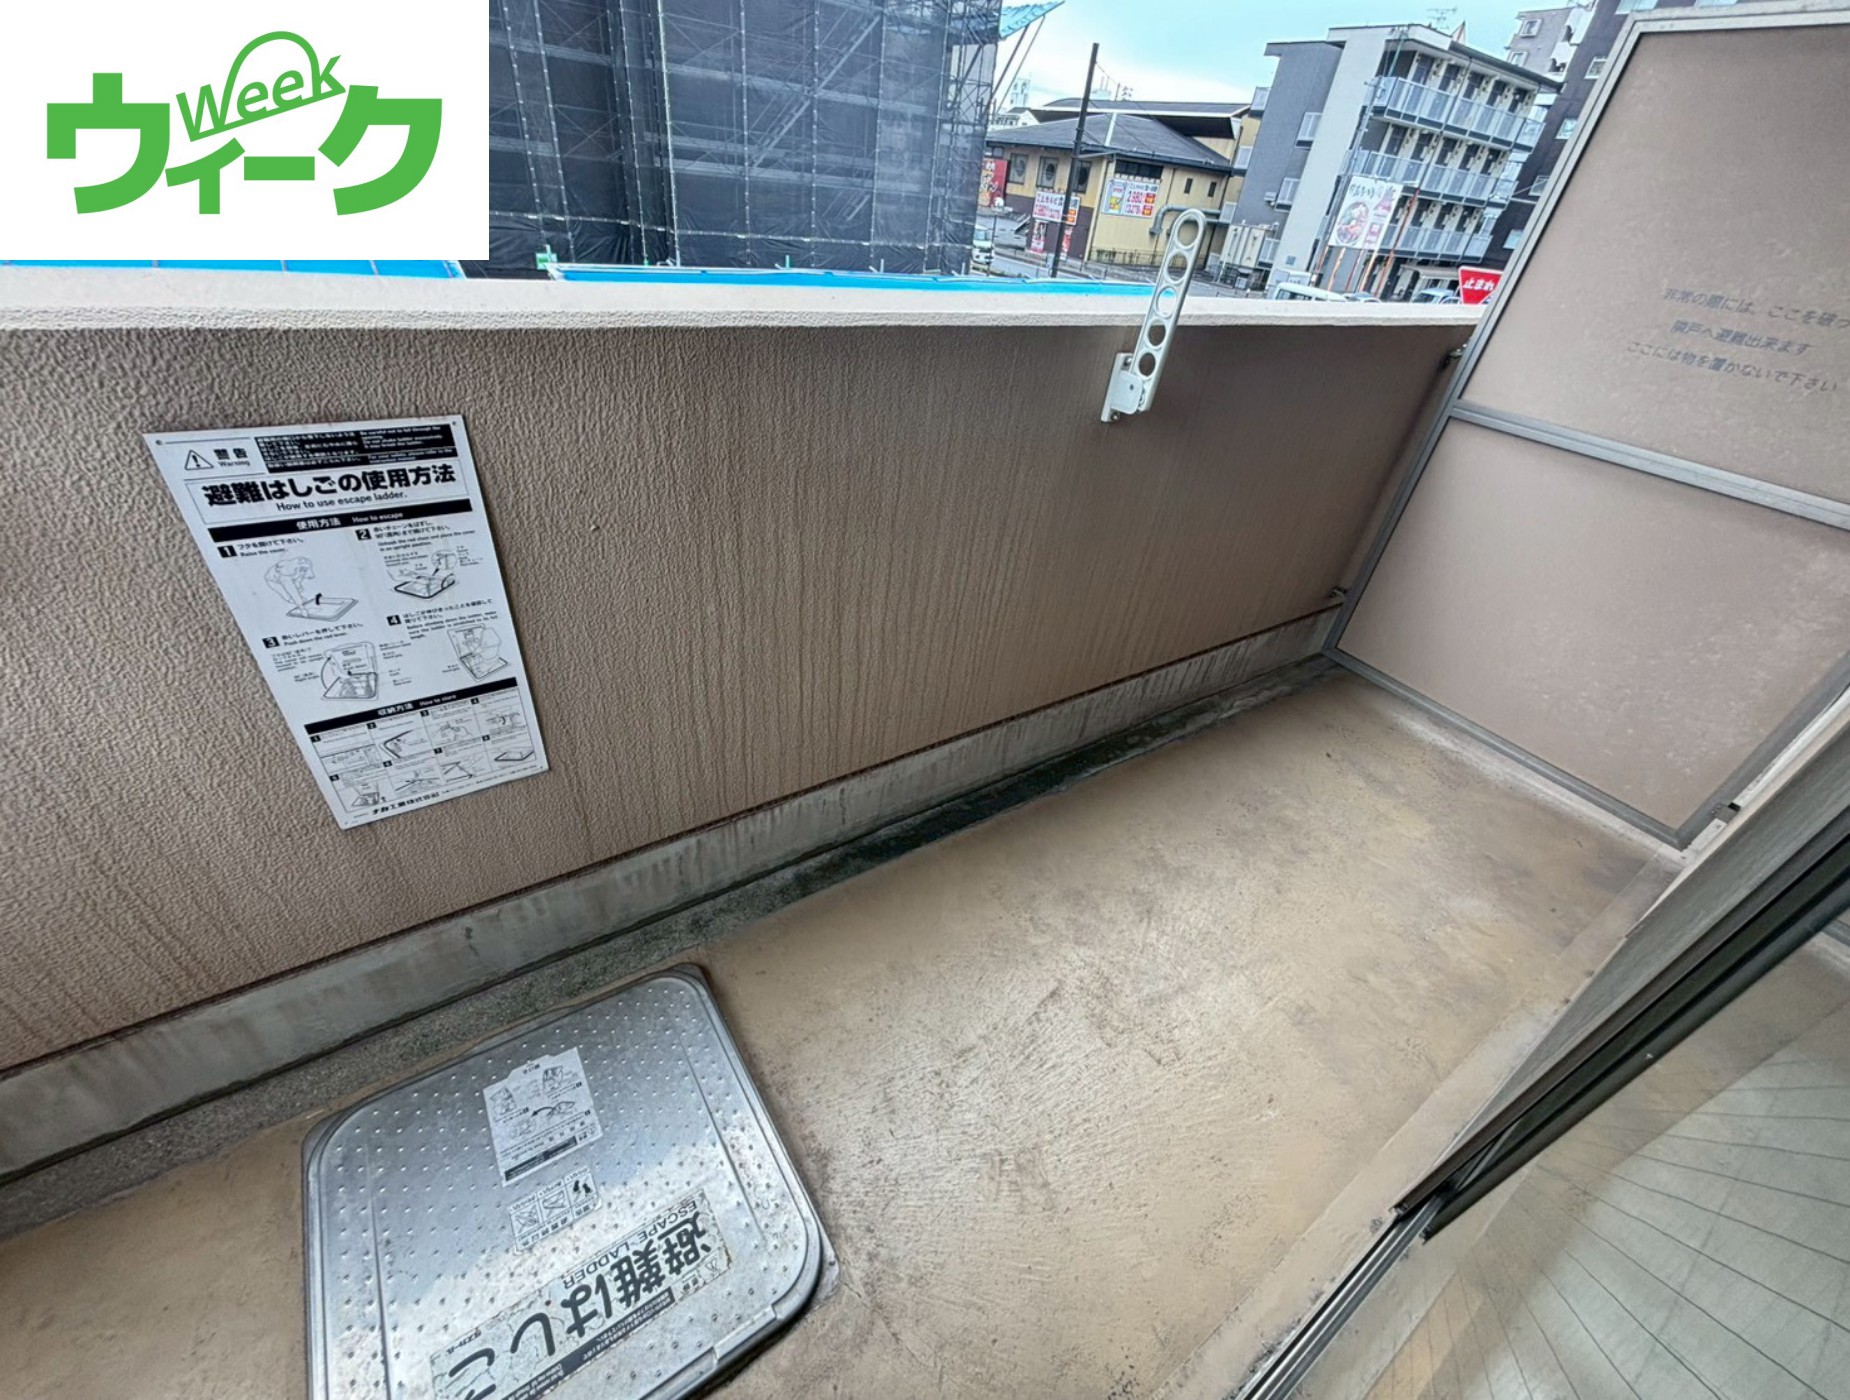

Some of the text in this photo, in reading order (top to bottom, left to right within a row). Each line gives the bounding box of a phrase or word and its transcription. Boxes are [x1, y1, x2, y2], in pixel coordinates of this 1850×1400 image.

[1463, 277, 1495, 292] 止まれ
[200, 463, 457, 507] 避難はしごの使用方法
[276, 490, 407, 511] How to use escape ladder.
[296, 517, 341, 530] 使用方法
[564, 1200, 697, 1290] ESCAPE LADDER
